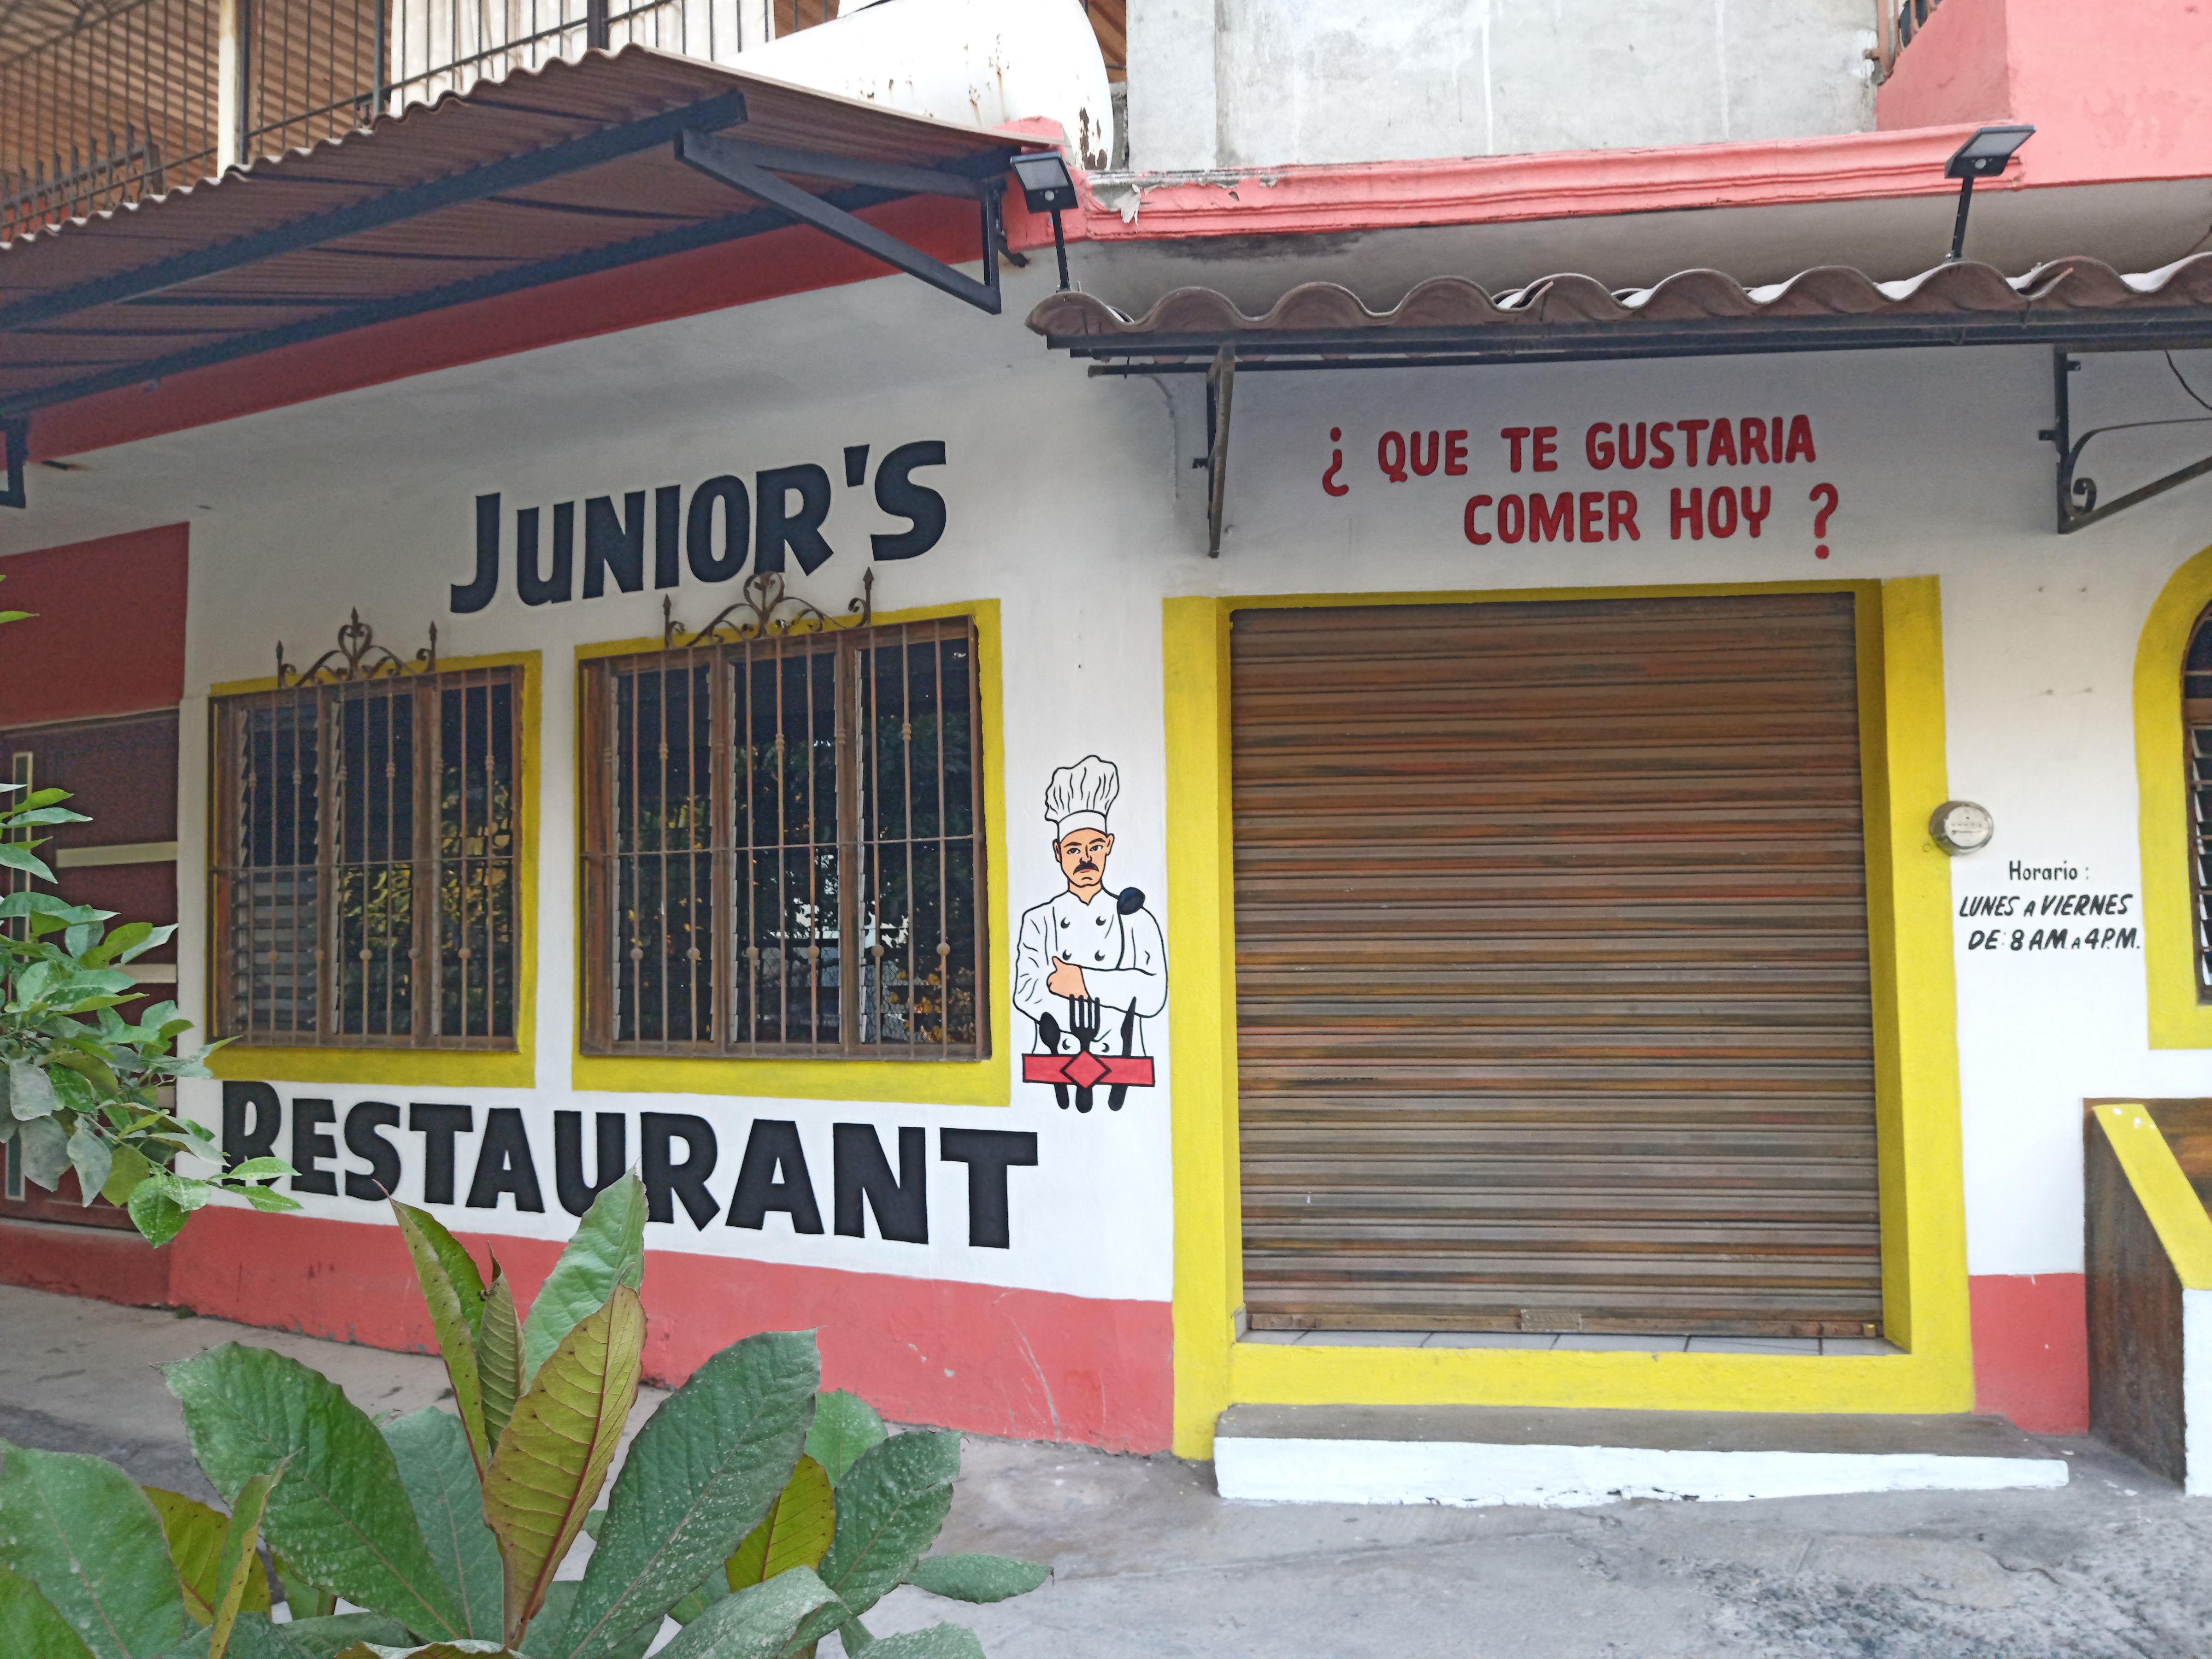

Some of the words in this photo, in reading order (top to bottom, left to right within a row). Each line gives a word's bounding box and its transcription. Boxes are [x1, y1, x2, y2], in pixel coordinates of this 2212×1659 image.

[1378, 430, 1468, 482] QUE
[1501, 427, 1557, 472] TE
[1586, 415, 1816, 470] GUSTARIA
[450, 440, 946, 613] JUNIOR'S
[1465, 490, 1640, 545] COMER
[1671, 486, 1771, 540] HOY
[1959, 895, 2020, 917] LUNES
[2040, 893, 2134, 917] VIERNES
[221, 1080, 1038, 1249] RESTAURANT
